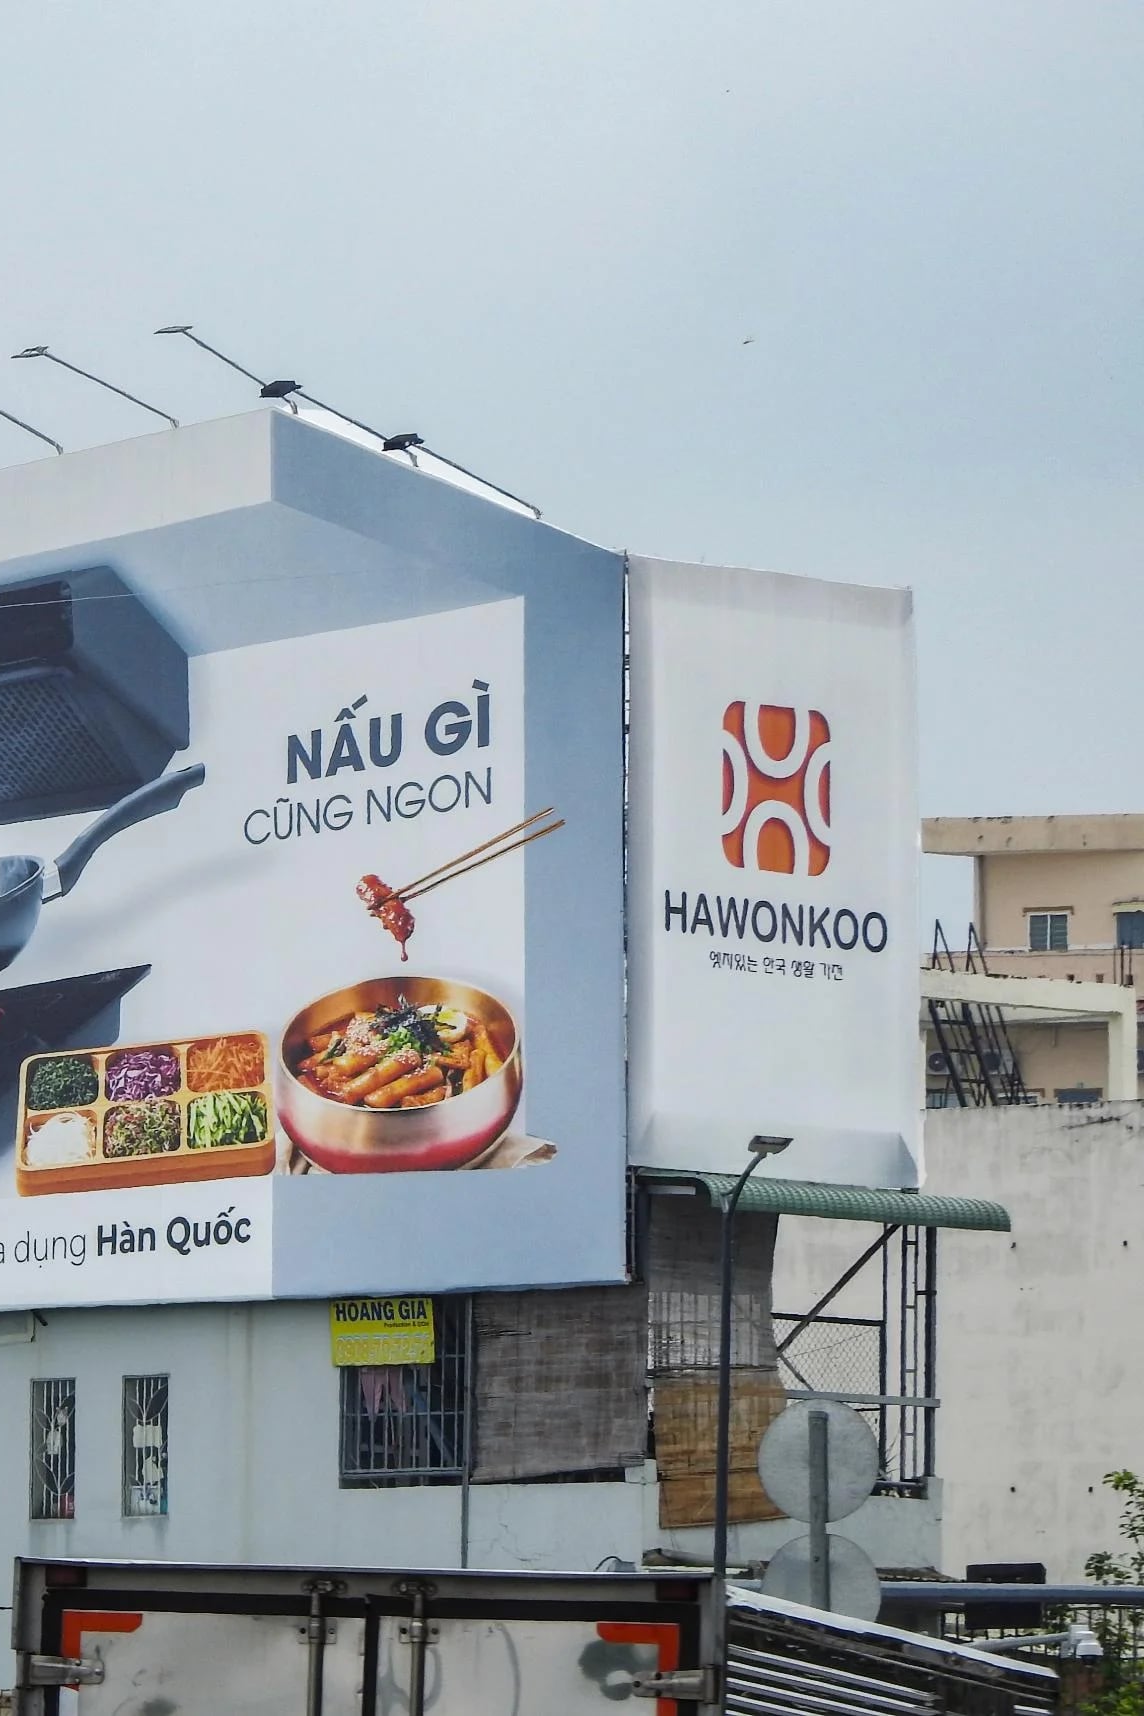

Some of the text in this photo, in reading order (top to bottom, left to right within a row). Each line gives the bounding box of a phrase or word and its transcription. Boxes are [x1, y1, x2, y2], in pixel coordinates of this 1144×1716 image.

[287, 678, 491, 785] NẤU GÌ
[244, 767, 492, 845] CŨNG NGON
[664, 889, 888, 953] HAWONKOO
[14, 1230, 87, 1269] dụng
[97, 1220, 156, 1257] Hàn
[166, 1206, 252, 1256] Quốc
[398, 1300, 428, 1320] GIA
